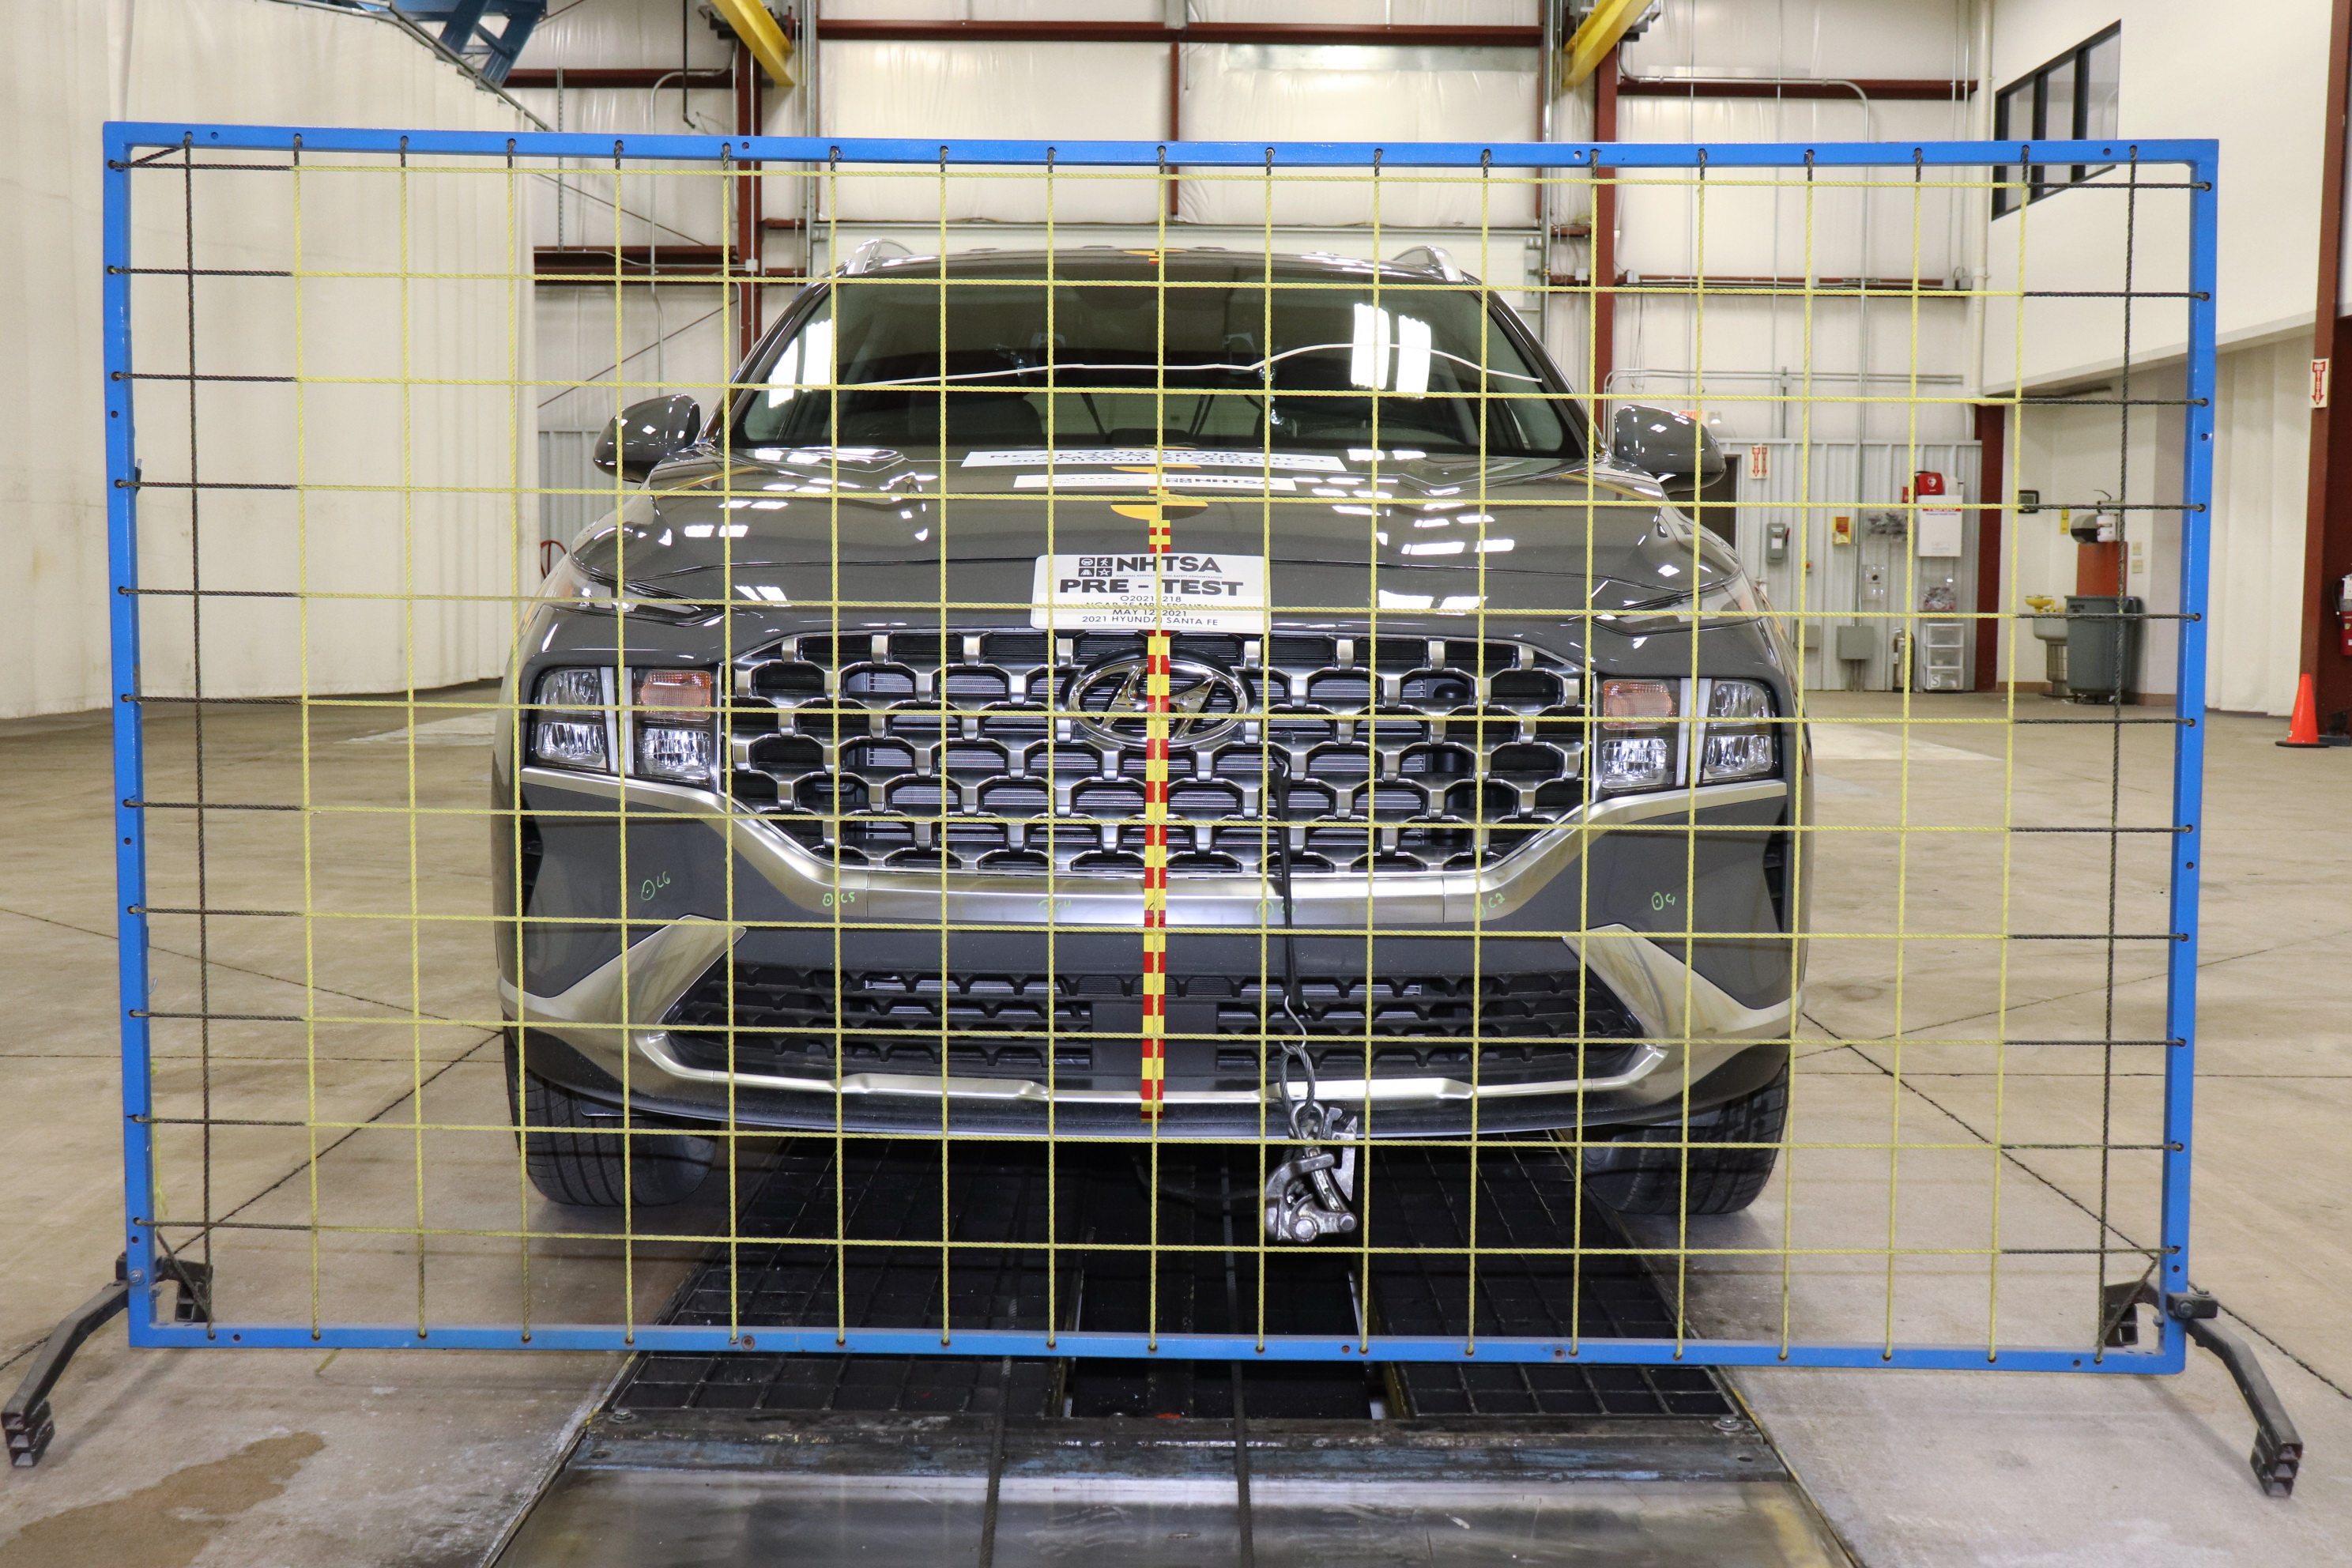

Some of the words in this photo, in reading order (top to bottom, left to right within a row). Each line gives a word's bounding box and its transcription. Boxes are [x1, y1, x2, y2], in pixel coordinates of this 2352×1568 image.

[1116, 556, 1223, 573] NHTSA
[1060, 579, 1129, 594] PRE
[1161, 579, 1244, 596] TEST
[1166, 616, 1203, 625] SANTA
